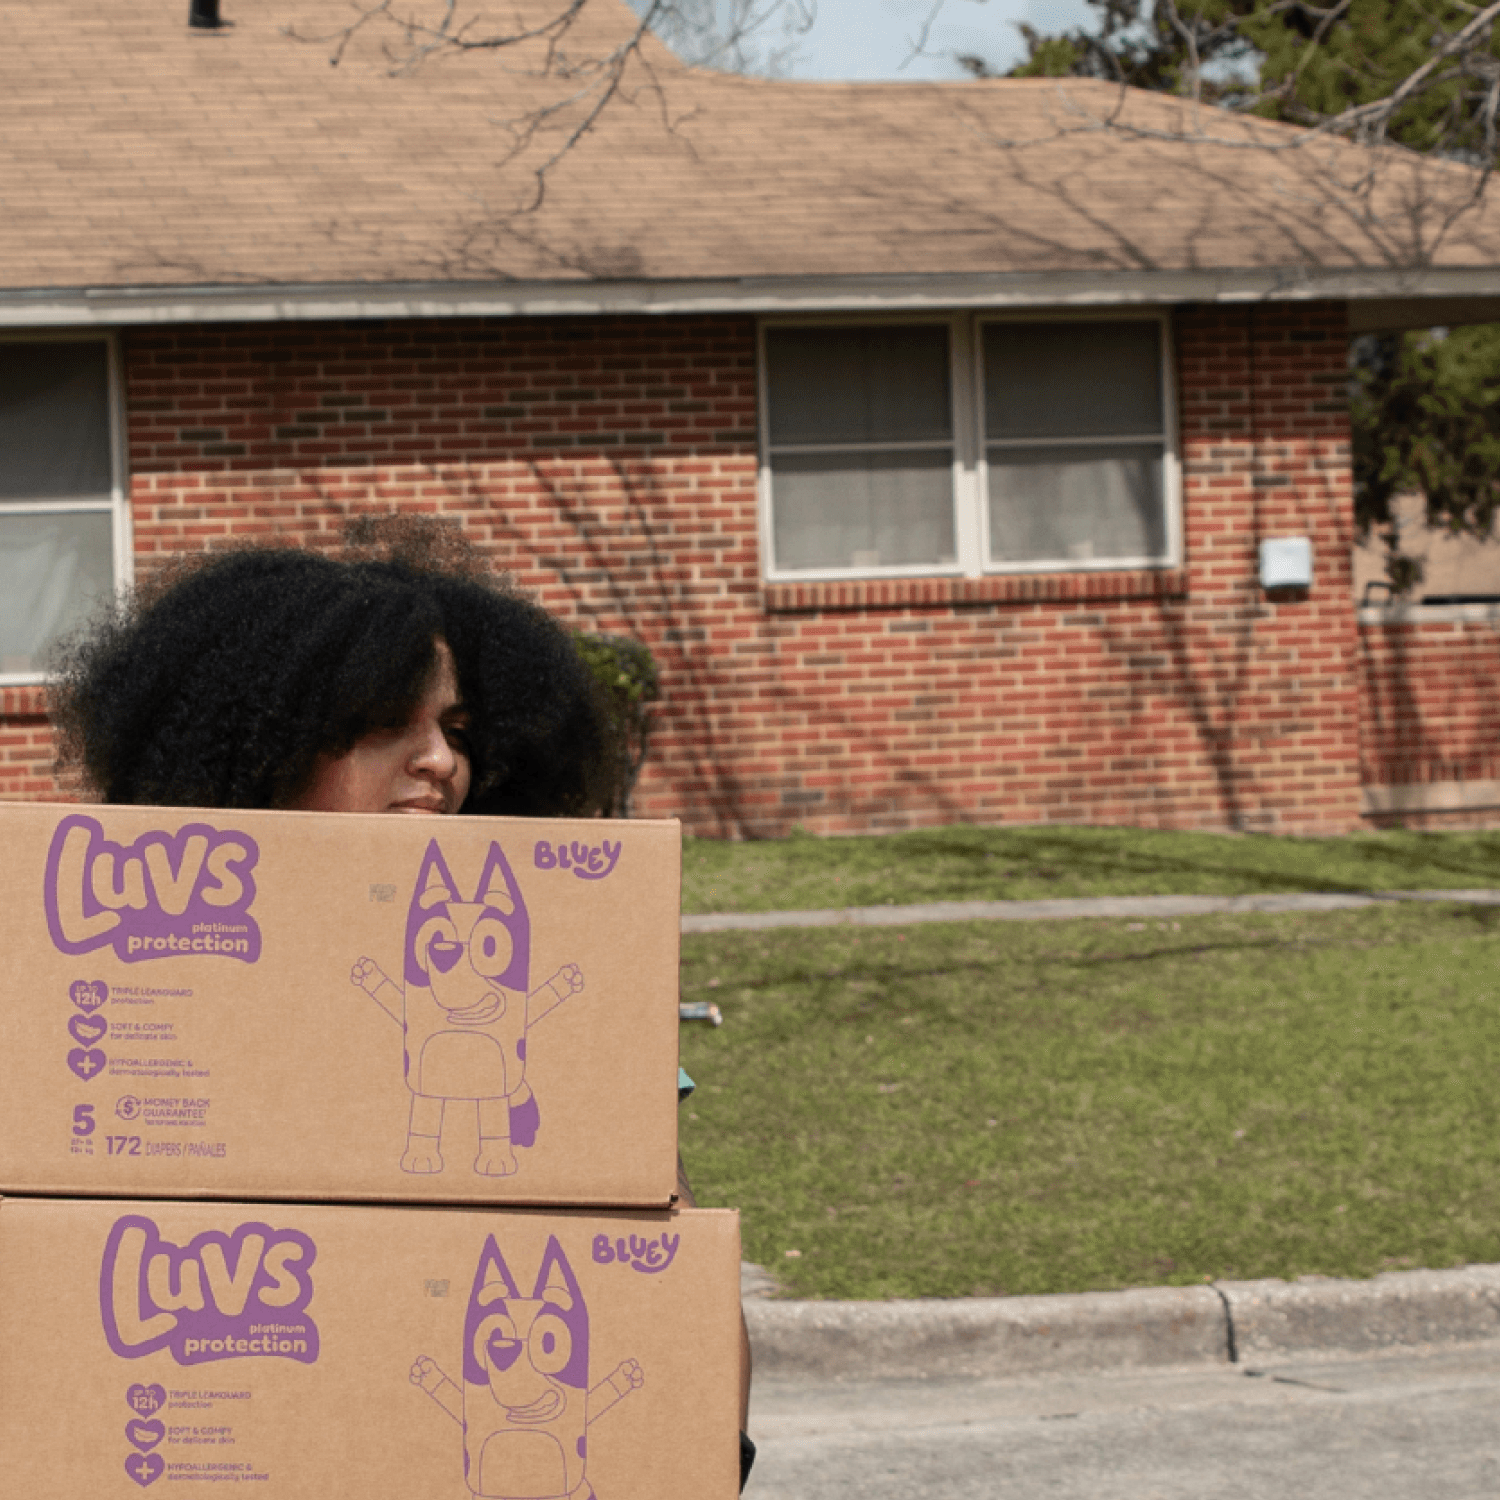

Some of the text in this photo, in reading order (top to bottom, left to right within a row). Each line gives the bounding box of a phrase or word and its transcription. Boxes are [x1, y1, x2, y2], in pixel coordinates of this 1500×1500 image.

[53, 822, 251, 947] Luvs
[191, 921, 249, 935] platinum
[126, 932, 249, 955] protection
[142, 1097, 210, 1109] MONEY BACK
[72, 1103, 96, 1137] 5
[105, 1135, 142, 1157] 172
[145, 1142, 181, 1157] DIAPERS
[187, 1140, 227, 1159] PAÑALES
[109, 1223, 308, 1349] Luvs
[249, 1322, 307, 1335] platinum
[183, 1334, 309, 1357] protection
[132, 1396, 159, 1411] 12h
